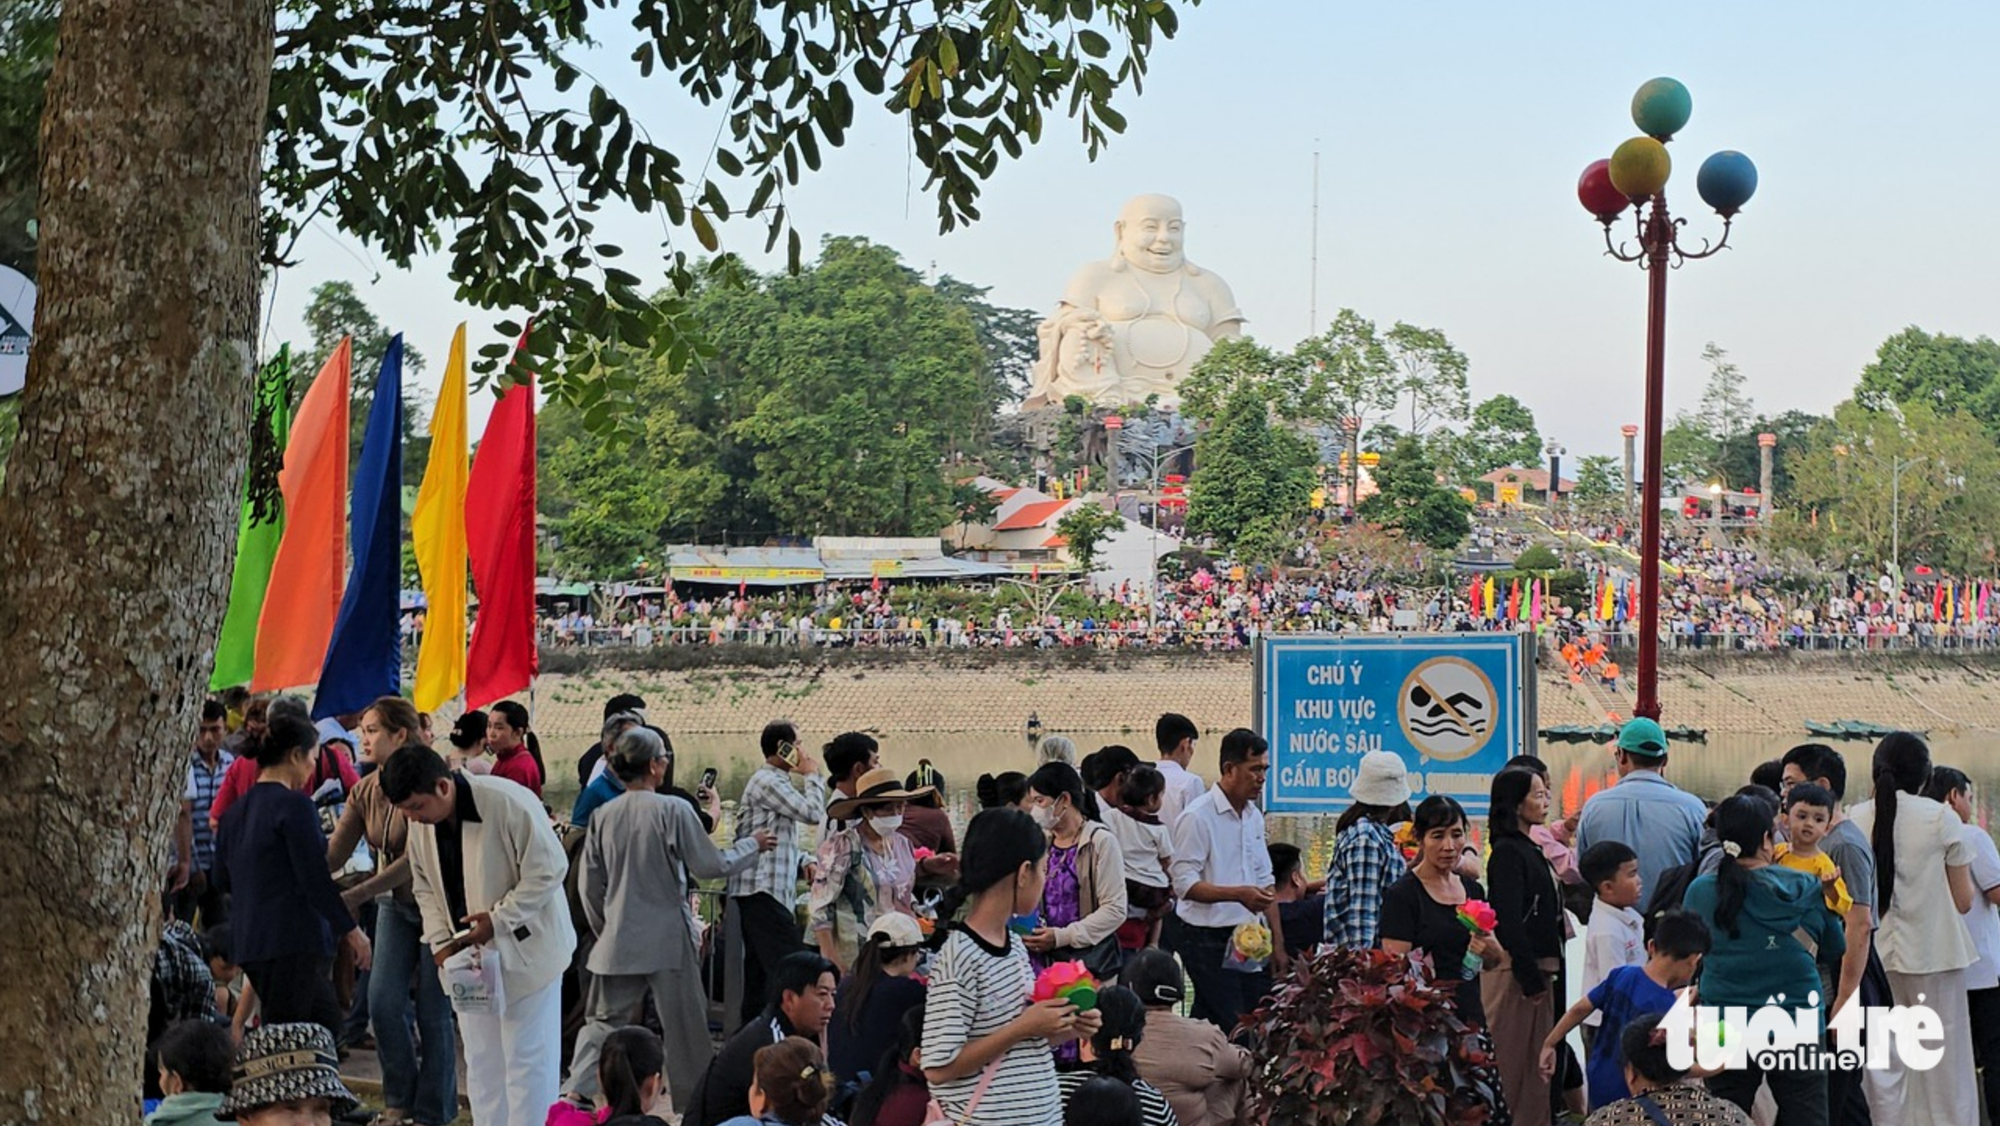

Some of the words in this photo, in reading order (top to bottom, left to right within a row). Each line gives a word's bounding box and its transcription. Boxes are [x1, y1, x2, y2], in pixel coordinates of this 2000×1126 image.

[1307, 660, 1345, 685] CHÚ
[1349, 660, 1363, 685] Ý
[1295, 699, 1333, 719] KHU
[1338, 696, 1376, 725] VỰC
[1290, 728, 1340, 753] NƯỚC
[1345, 730, 1382, 753] SÂU
[1280, 758, 1320, 787] CẤM
